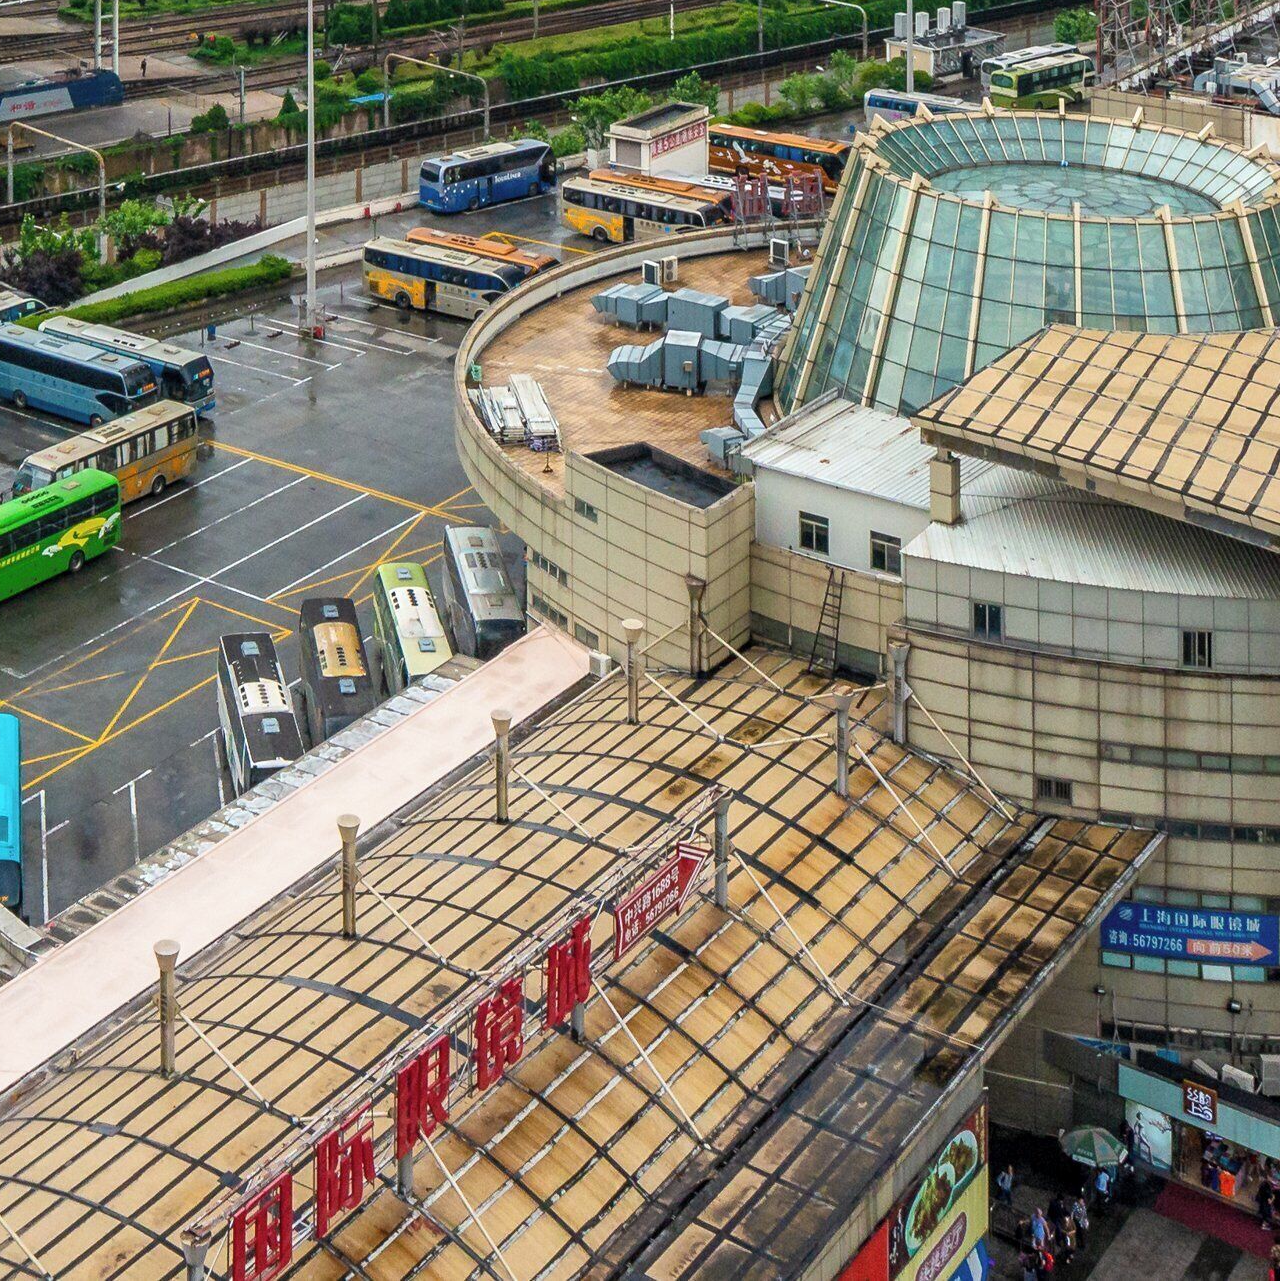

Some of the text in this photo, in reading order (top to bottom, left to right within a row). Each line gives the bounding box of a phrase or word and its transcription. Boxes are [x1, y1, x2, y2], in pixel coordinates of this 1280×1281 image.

[624, 866, 680, 926] 中兴路1688号
[1139, 908, 1261, 932] 上海国际眼镜城
[232, 914, 592, 1281] 国际眼镜城
